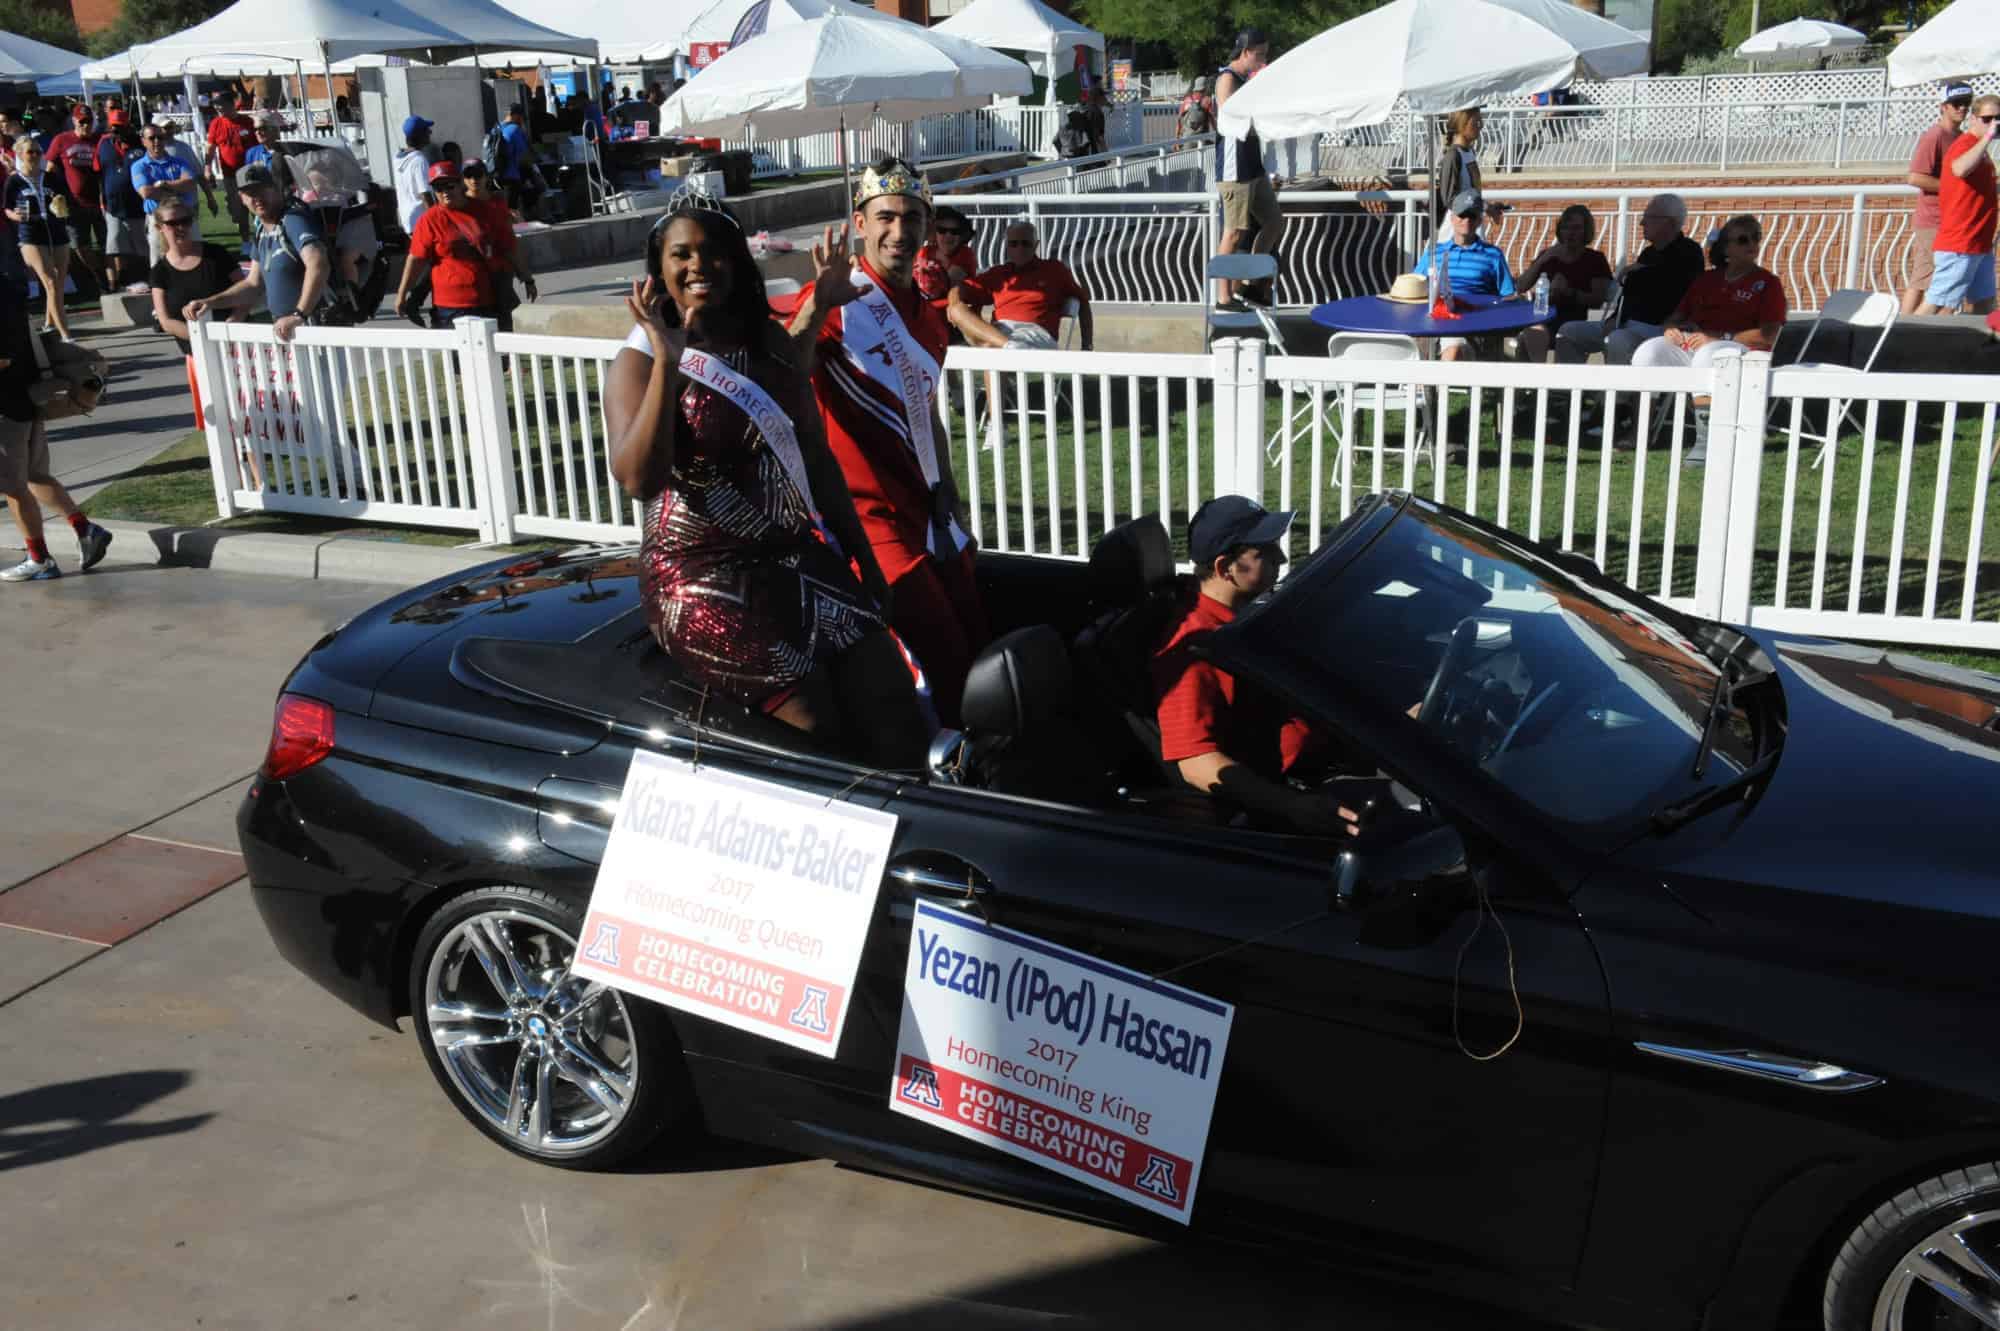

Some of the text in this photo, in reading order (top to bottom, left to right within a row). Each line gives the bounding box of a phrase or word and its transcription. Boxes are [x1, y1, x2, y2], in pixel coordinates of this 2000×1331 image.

[869, 302, 891, 327] A
[682, 353, 705, 377] A
[622, 776, 876, 894] Kiana Adams-Baker
[710, 873, 754, 904] 2017
[585, 923, 620, 966] A
[624, 879, 823, 961] Homecoming Queen
[633, 956, 781, 1018] CELEBRATION
[638, 933, 785, 996] HOMECOMING
[789, 986, 832, 1034] A
[917, 927, 1212, 1081] Yezan (IPod) Hassan
[1027, 1038, 1079, 1073] 2017
[903, 1064, 943, 1110] A
[946, 1036, 1152, 1136] Homecoming King
[957, 1102, 1122, 1178] CELEBRATION
[959, 1082, 1127, 1160] HOMECOMING
[1135, 1154, 1179, 1203] A
